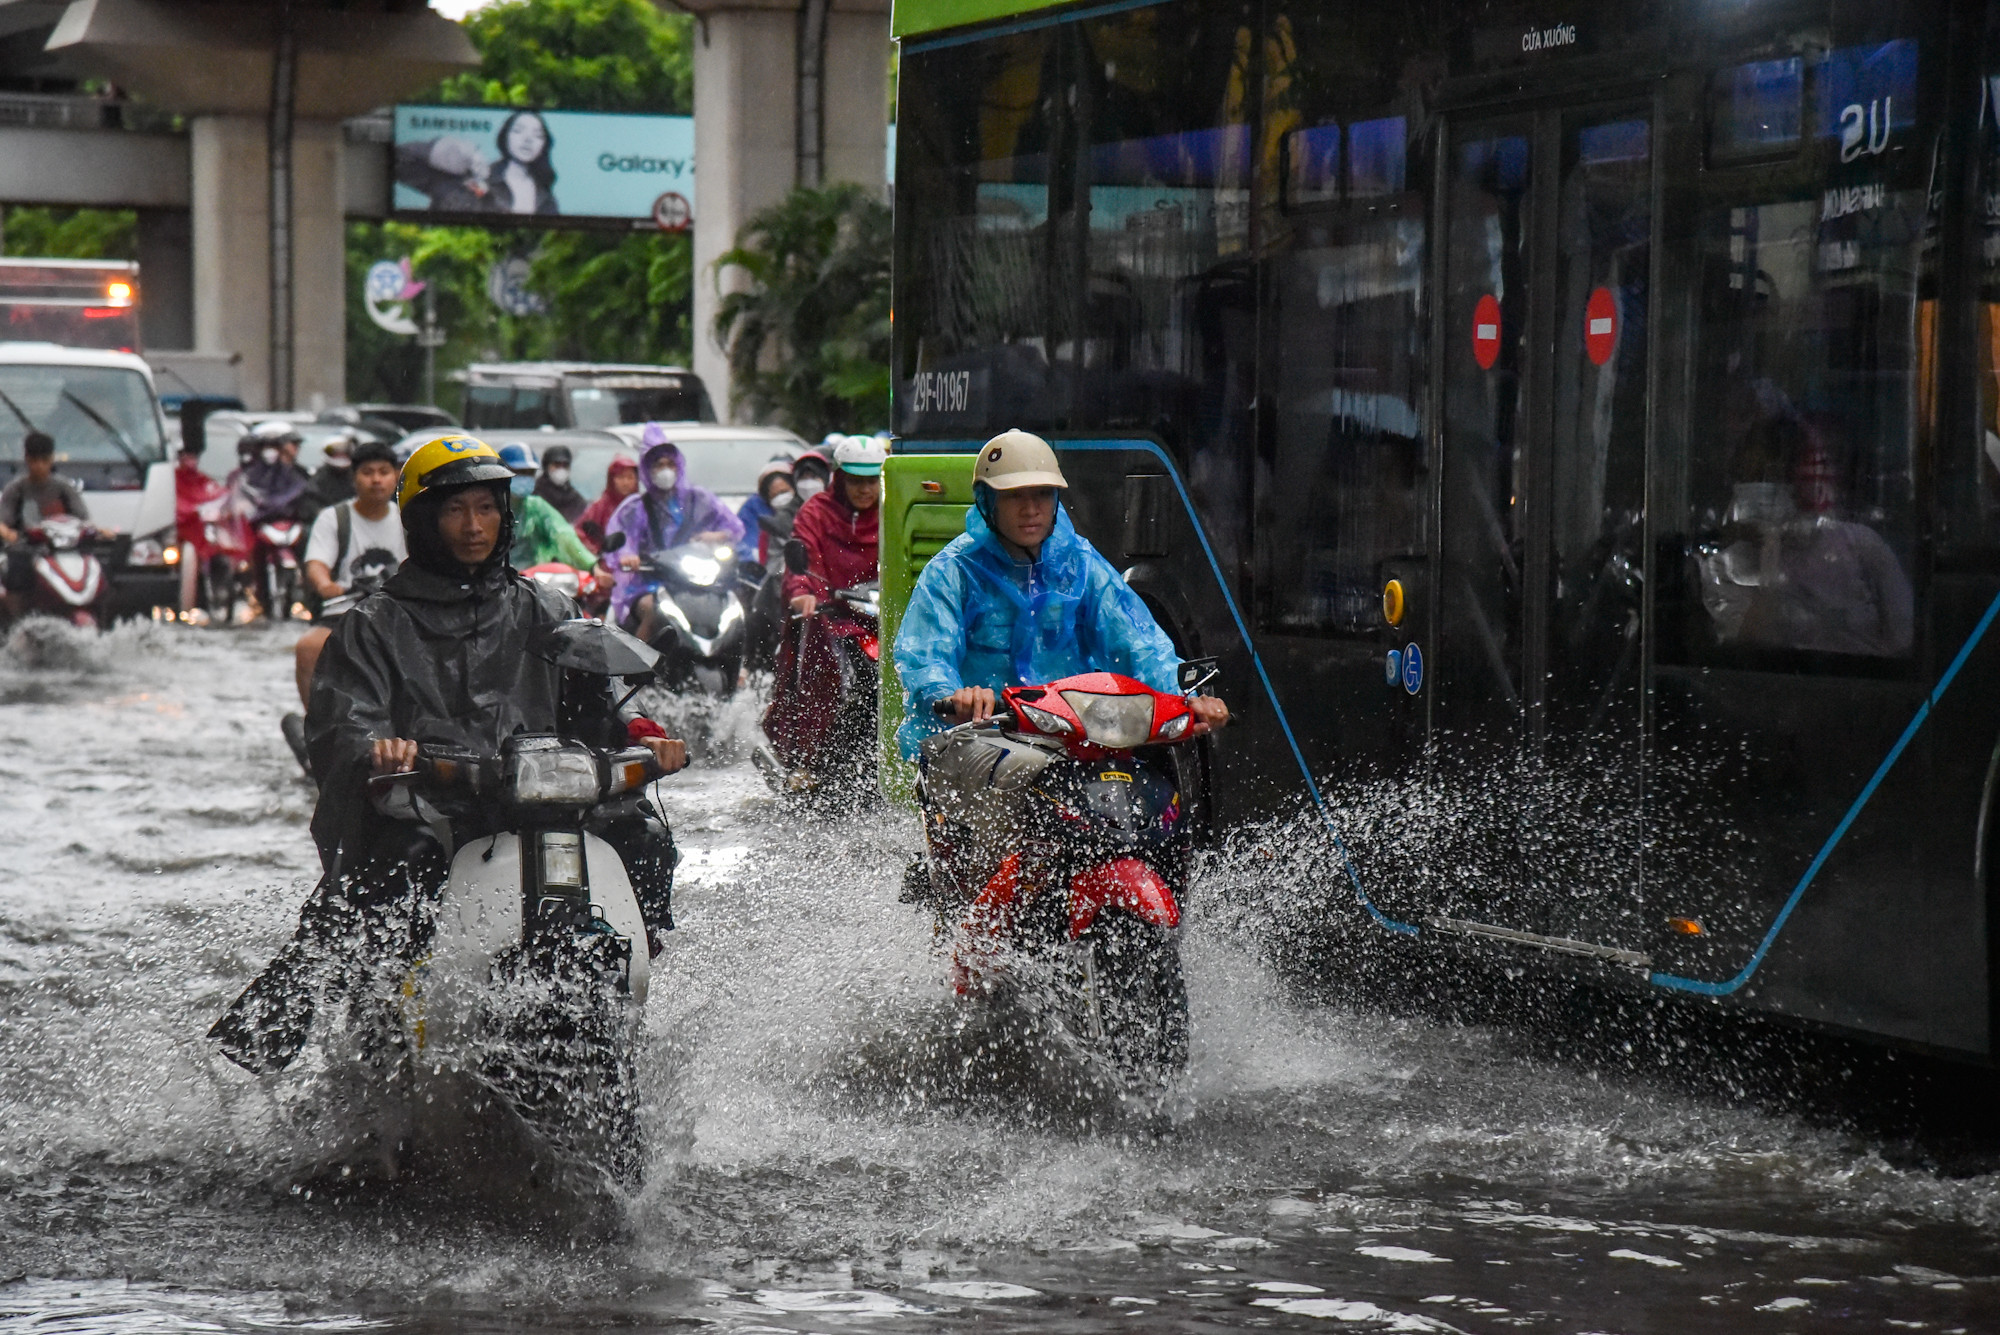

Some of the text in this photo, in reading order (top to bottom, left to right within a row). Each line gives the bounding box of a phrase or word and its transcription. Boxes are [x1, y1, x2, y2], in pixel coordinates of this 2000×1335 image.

[1522, 21, 1576, 51] CỬA XUỐNG
[409, 115, 493, 133] SAMSUNG
[598, 153, 685, 179] Galaxy
[913, 371, 970, 412] 29F-01967
